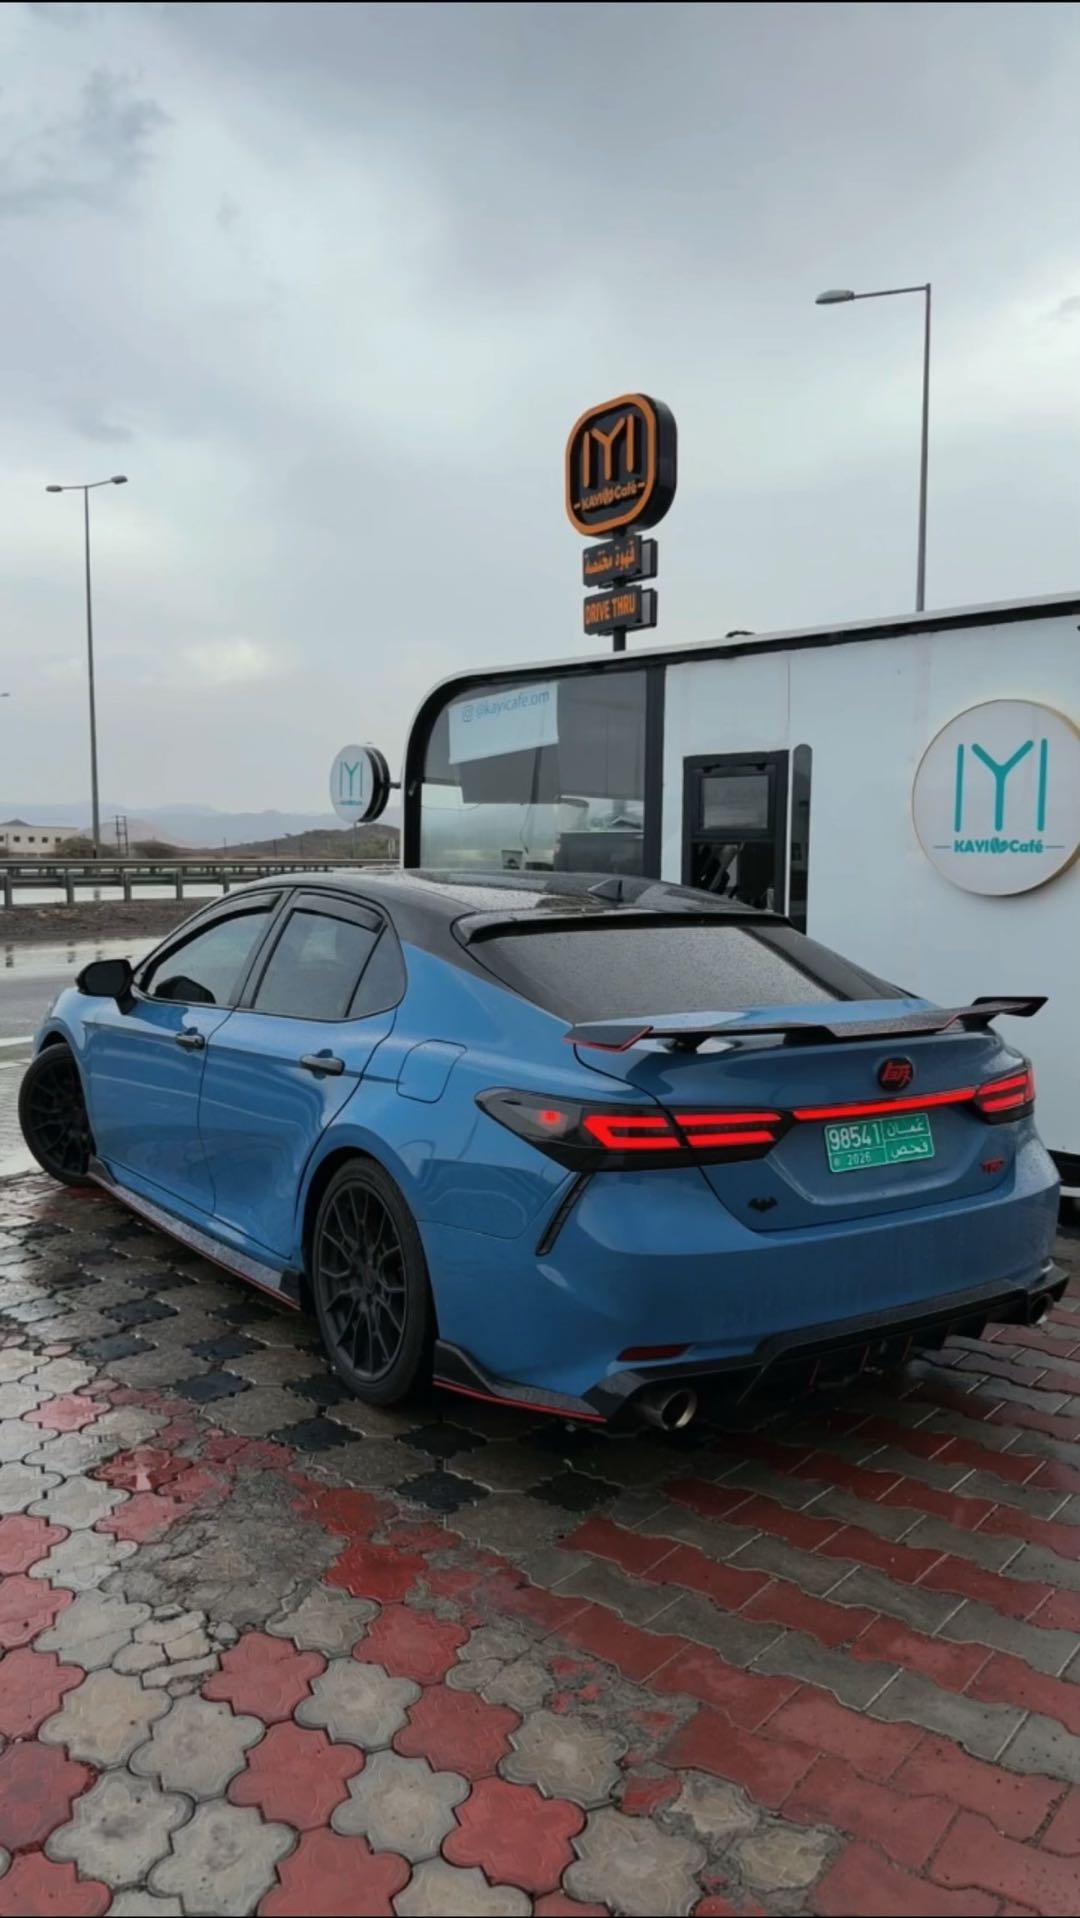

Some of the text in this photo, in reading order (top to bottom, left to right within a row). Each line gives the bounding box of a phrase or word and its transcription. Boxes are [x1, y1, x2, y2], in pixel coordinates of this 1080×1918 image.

[614, 540, 636, 571] قهوة
[585, 592, 636, 625] DRIVE THRU
[476, 690, 550, 719] @kayicafe.om
[954, 838, 1044, 854] KAYI Café
[828, 1122, 881, 1151] 98541
[890, 1140, 928, 1159] فحص
